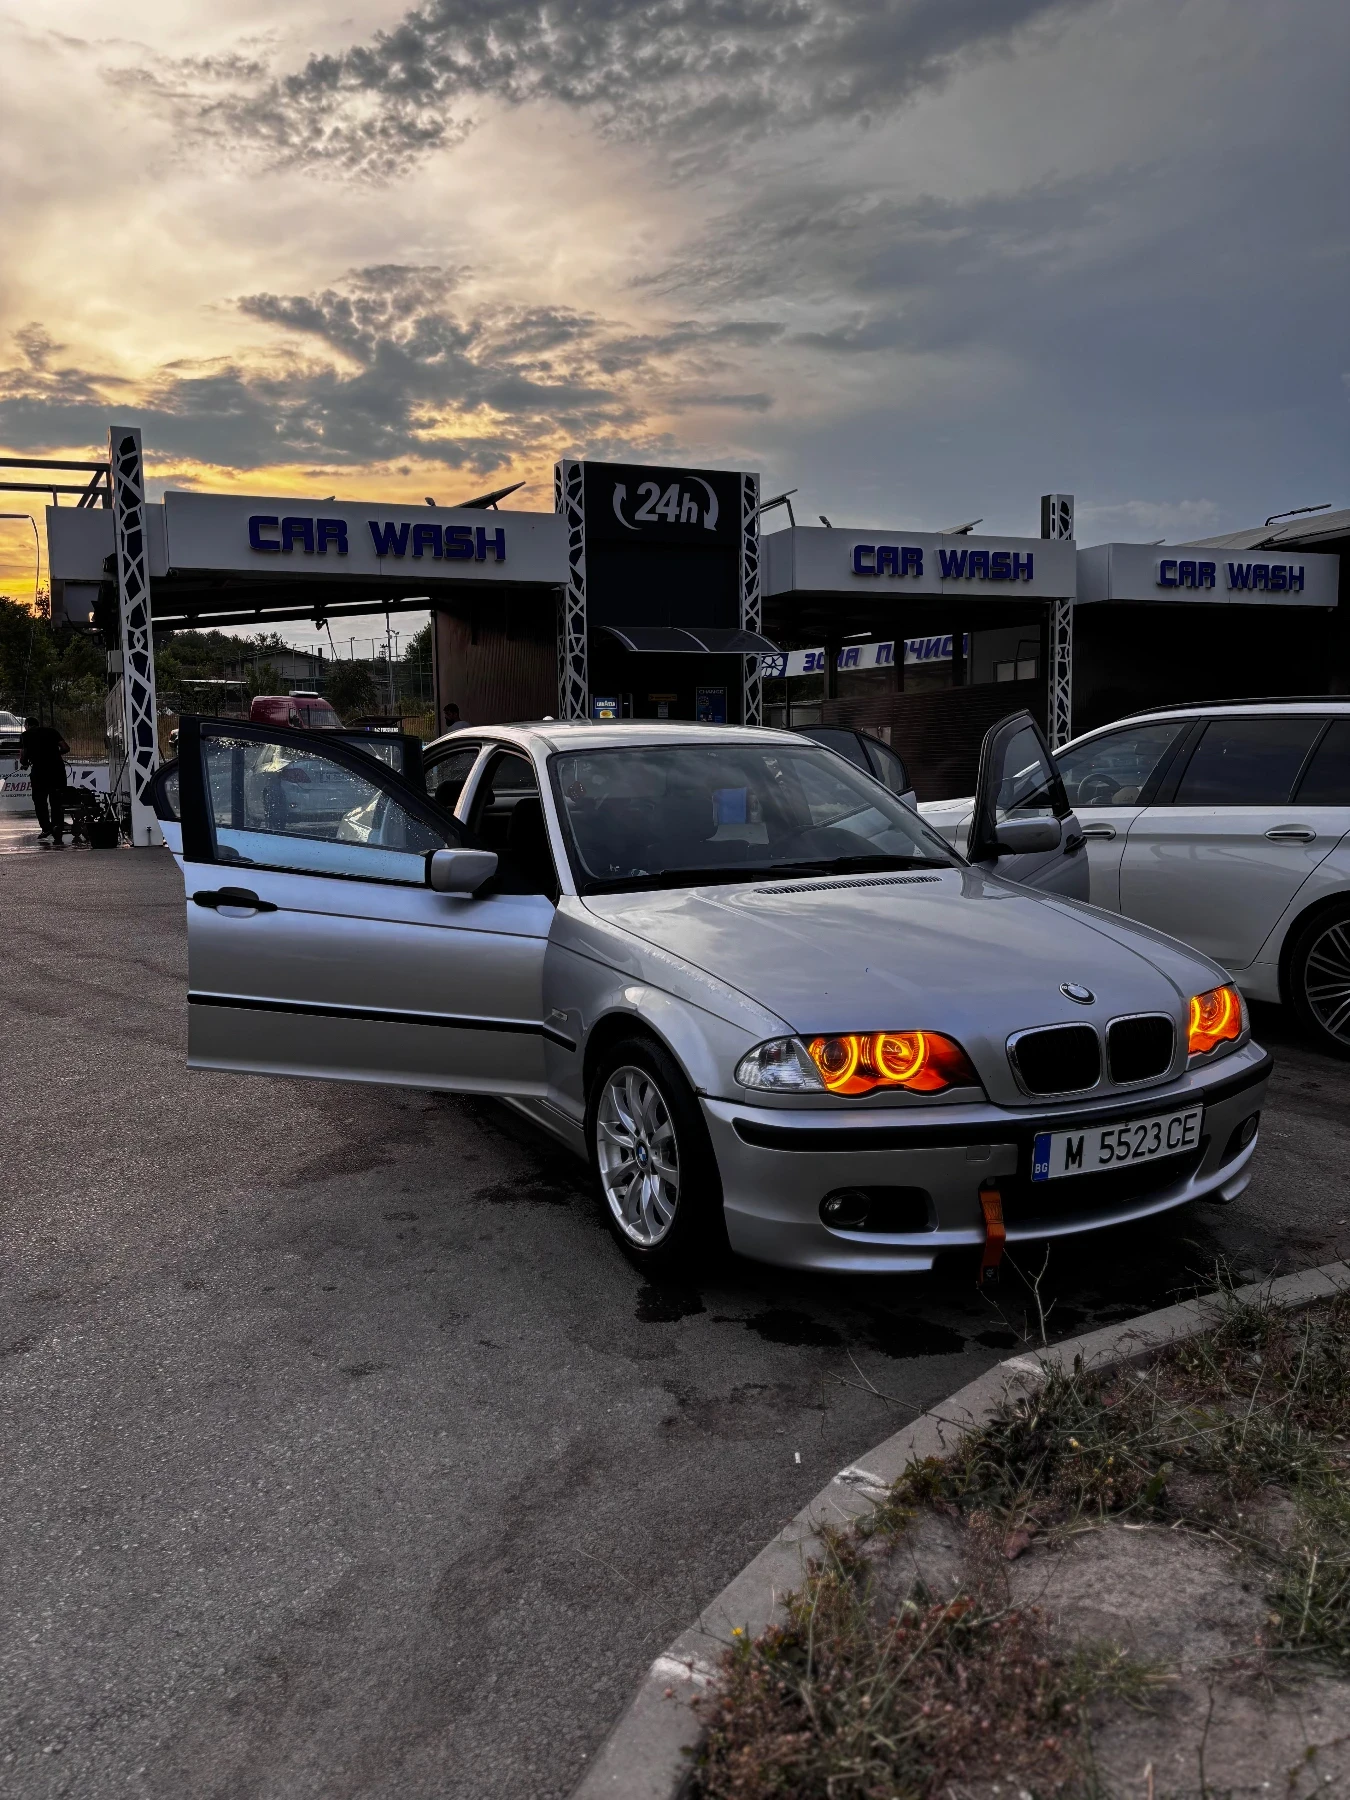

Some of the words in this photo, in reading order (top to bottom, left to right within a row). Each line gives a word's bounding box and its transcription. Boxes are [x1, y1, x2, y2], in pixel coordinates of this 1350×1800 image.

[635, 482, 698, 523] 24h
[248, 515, 348, 555] CAR
[369, 520, 507, 562] WASH
[851, 543, 924, 577] CAR
[936, 549, 1035, 581] WASH
[1158, 559, 1217, 588] CAR
[1227, 561, 1305, 591] WASH
[1034, 1163, 1048, 1174] BG
[1064, 1136, 1084, 1170] M
